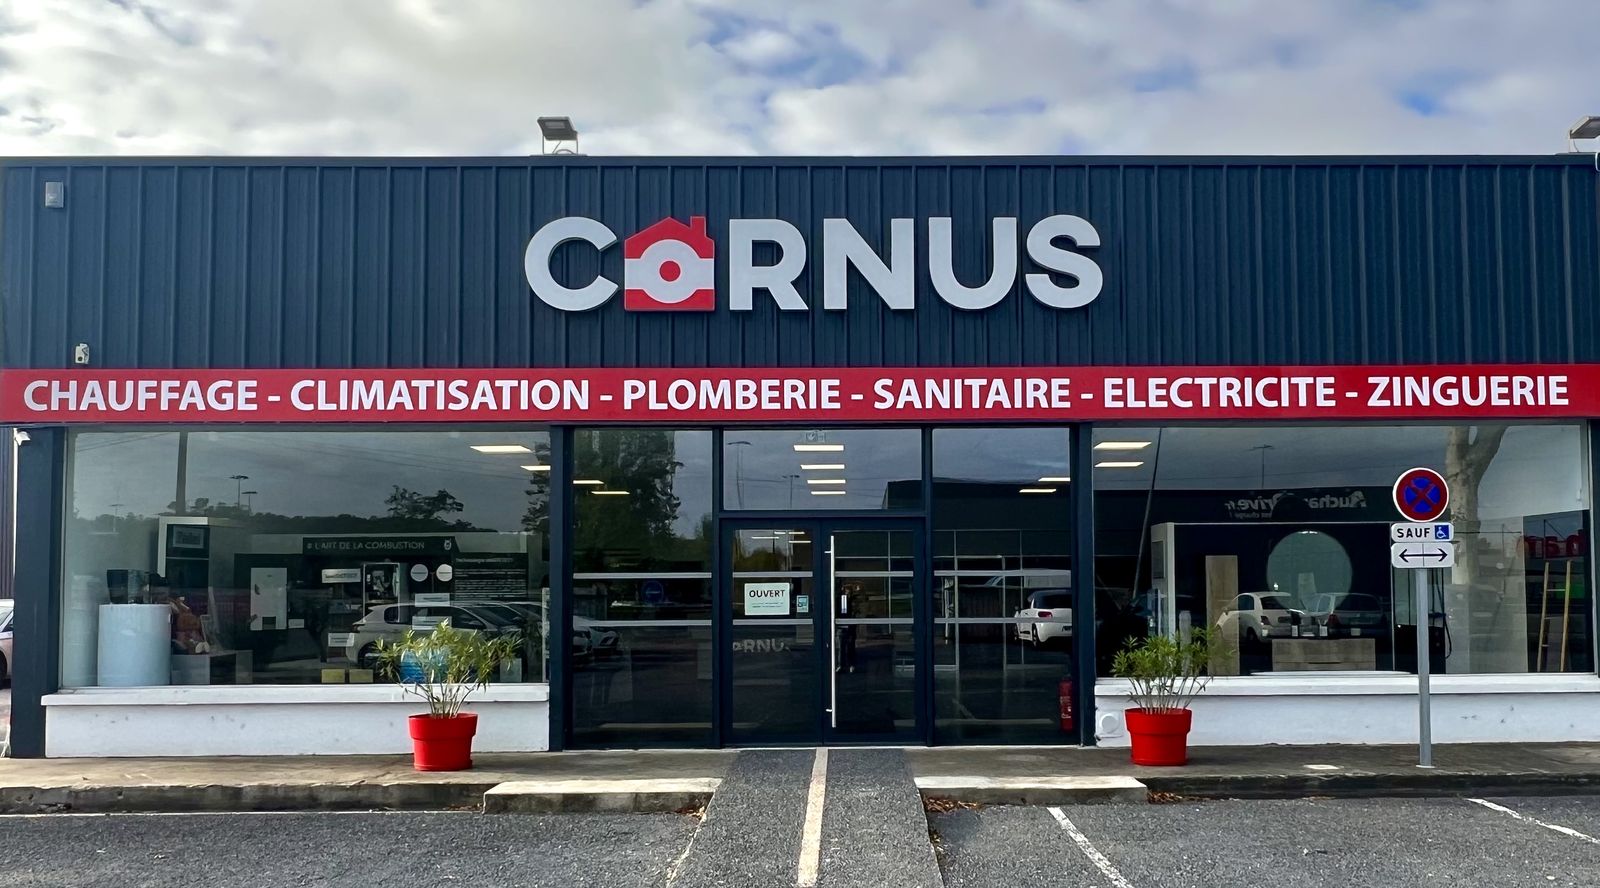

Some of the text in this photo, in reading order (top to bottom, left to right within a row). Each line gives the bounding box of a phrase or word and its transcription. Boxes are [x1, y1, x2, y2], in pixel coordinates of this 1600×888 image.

[524, 214, 1103, 311] CORNUS
[23, 379, 258, 411] CHAUFFAGE
[290, 379, 589, 411] CLIMATISATION
[623, 379, 841, 410] PLOMBERIE
[873, 378, 1071, 410] SANITAIRE
[1104, 377, 1336, 408] ELECTRICITE
[1367, 375, 1569, 407] ZINGUERIE
[1396, 527, 1431, 538] SAUF
[340, 541, 351, 550] DE
[353, 541, 363, 550] LA
[364, 541, 425, 550] COMBUSTION
[749, 589, 785, 598] OUVERT
